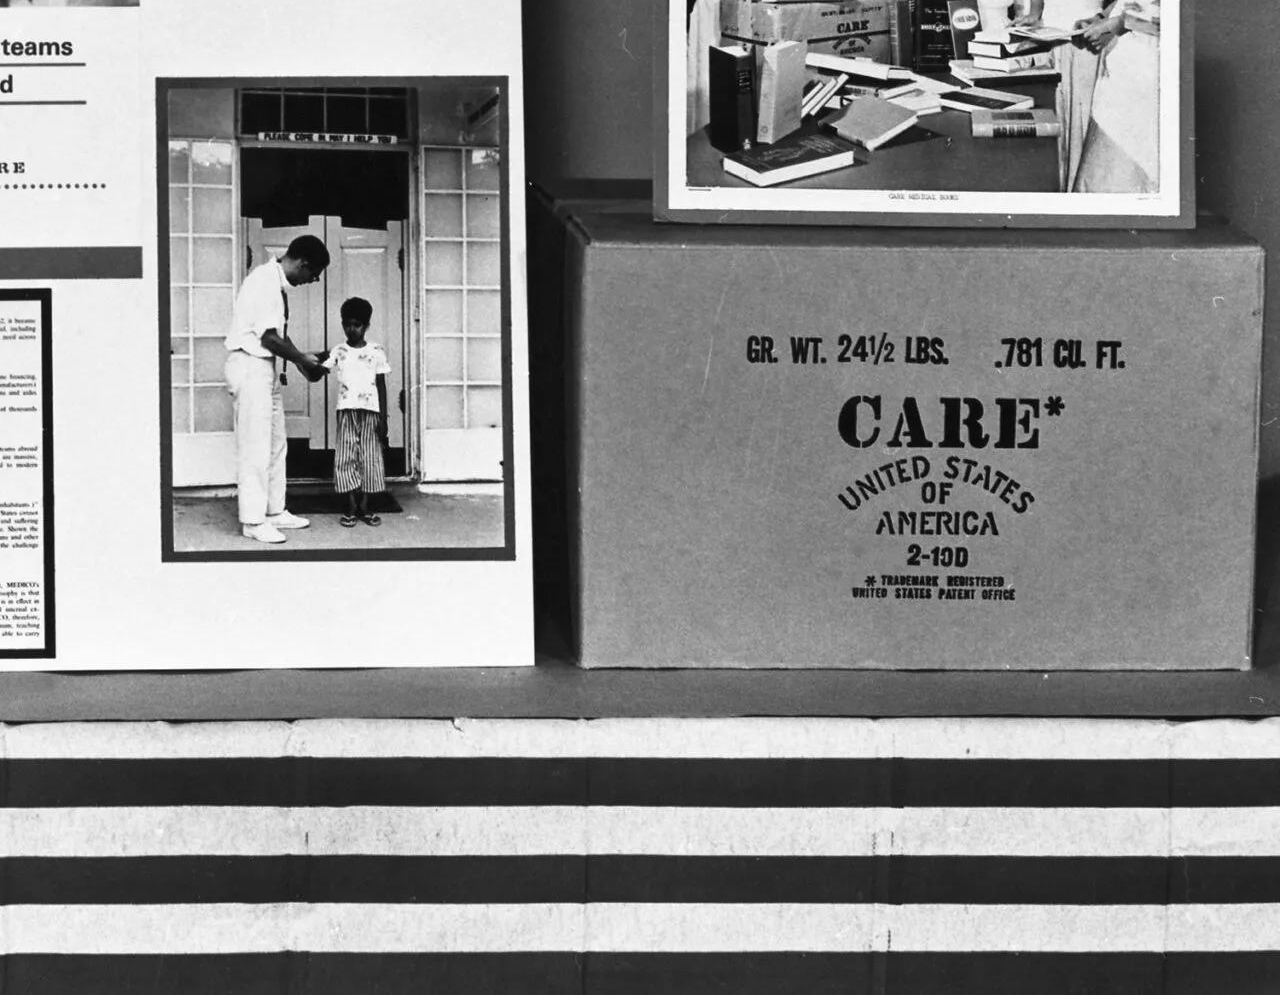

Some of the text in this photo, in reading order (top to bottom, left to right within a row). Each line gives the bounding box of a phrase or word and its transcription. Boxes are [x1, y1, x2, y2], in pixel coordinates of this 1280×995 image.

[837, 20, 870, 34] CARE
[0, 39, 73, 56] teams
[746, 335, 778, 364] GR.
[790, 336, 827, 364] WT.
[904, 336, 949, 365] LBS.
[994, 337, 1043, 368] .781
[1053, 339, 1086, 370] CU.
[1096, 340, 1125, 369] FT.
[837, 456, 1036, 514] UNITED STATES
[921, 482, 953, 505] OF
[875, 510, 999, 536] AMERICA
[906, 543, 969, 568] 2-10D
[881, 574, 1005, 588] TRADEMARK REGISTERED
[852, 587, 1016, 601] UNITED STATES PATENT OFFICE
